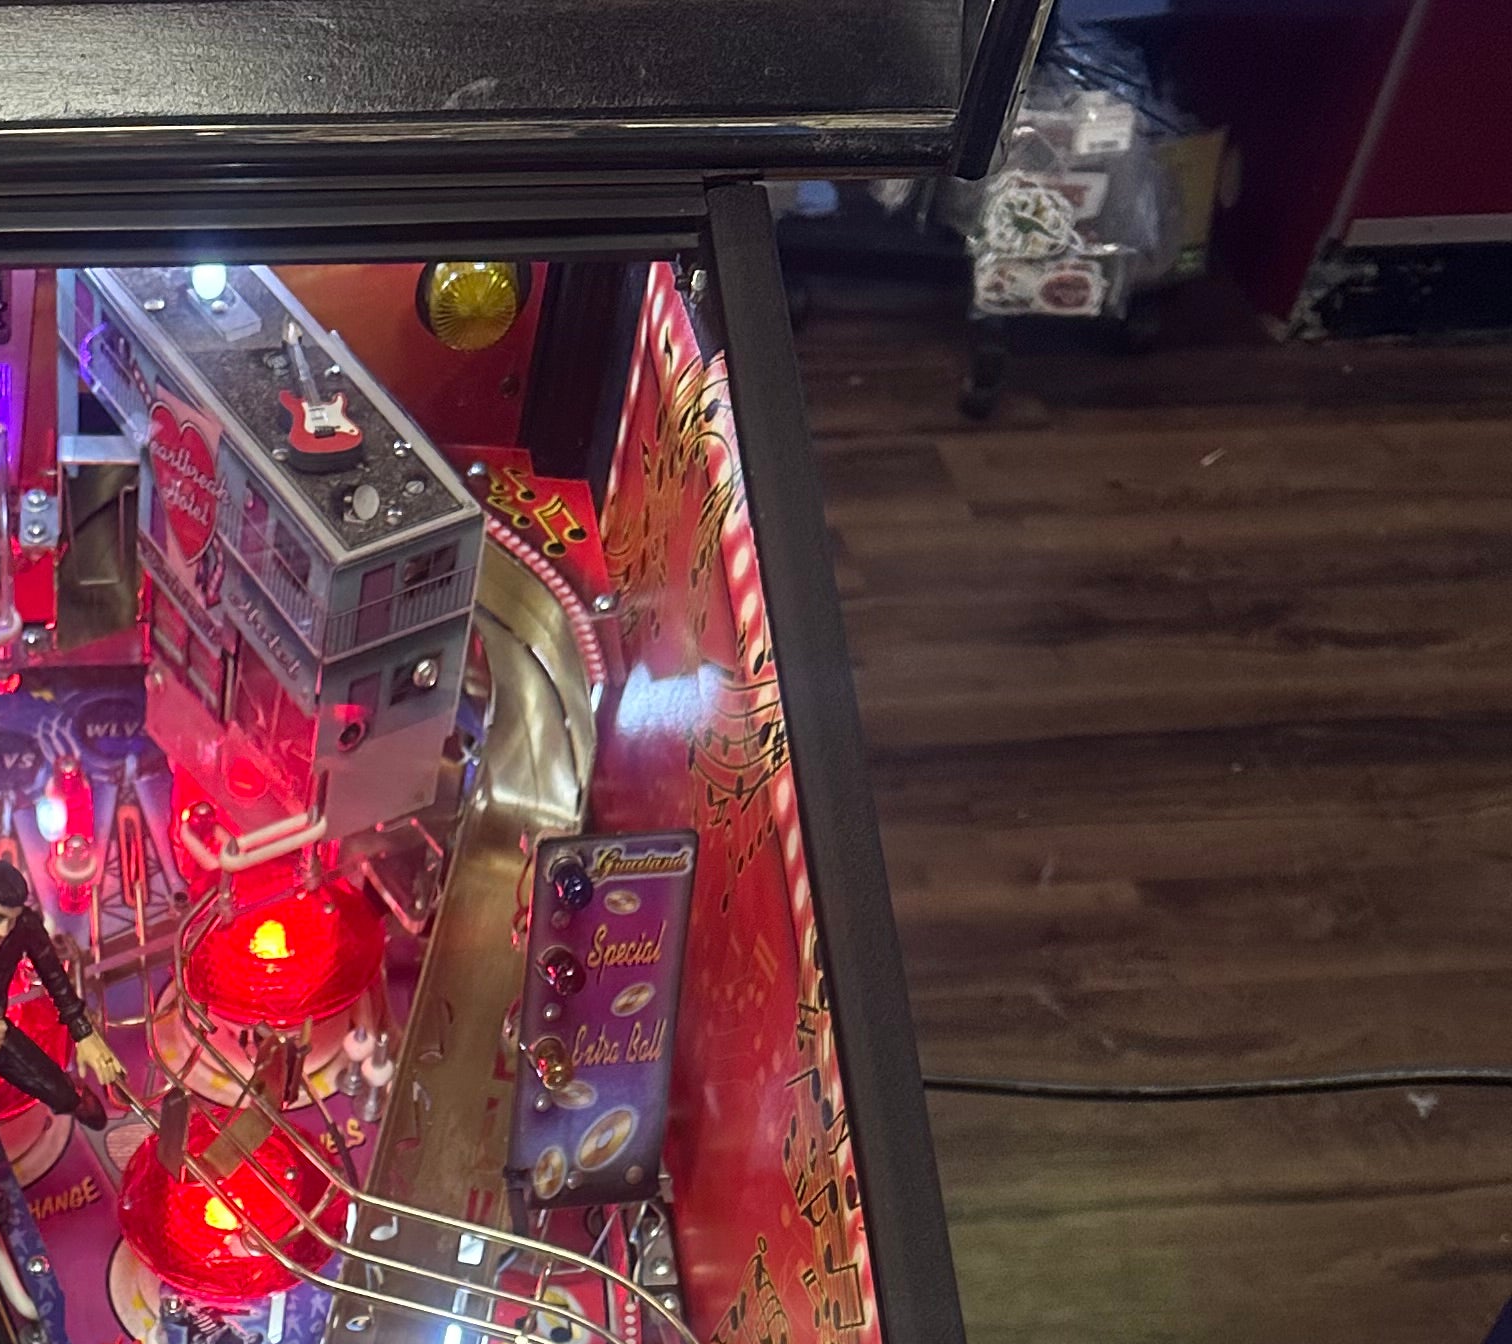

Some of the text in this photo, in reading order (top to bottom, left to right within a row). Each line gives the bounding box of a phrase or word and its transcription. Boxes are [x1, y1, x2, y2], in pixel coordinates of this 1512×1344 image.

[587, 919, 669, 984] Special
[571, 1017, 669, 1067] Extra Ball
